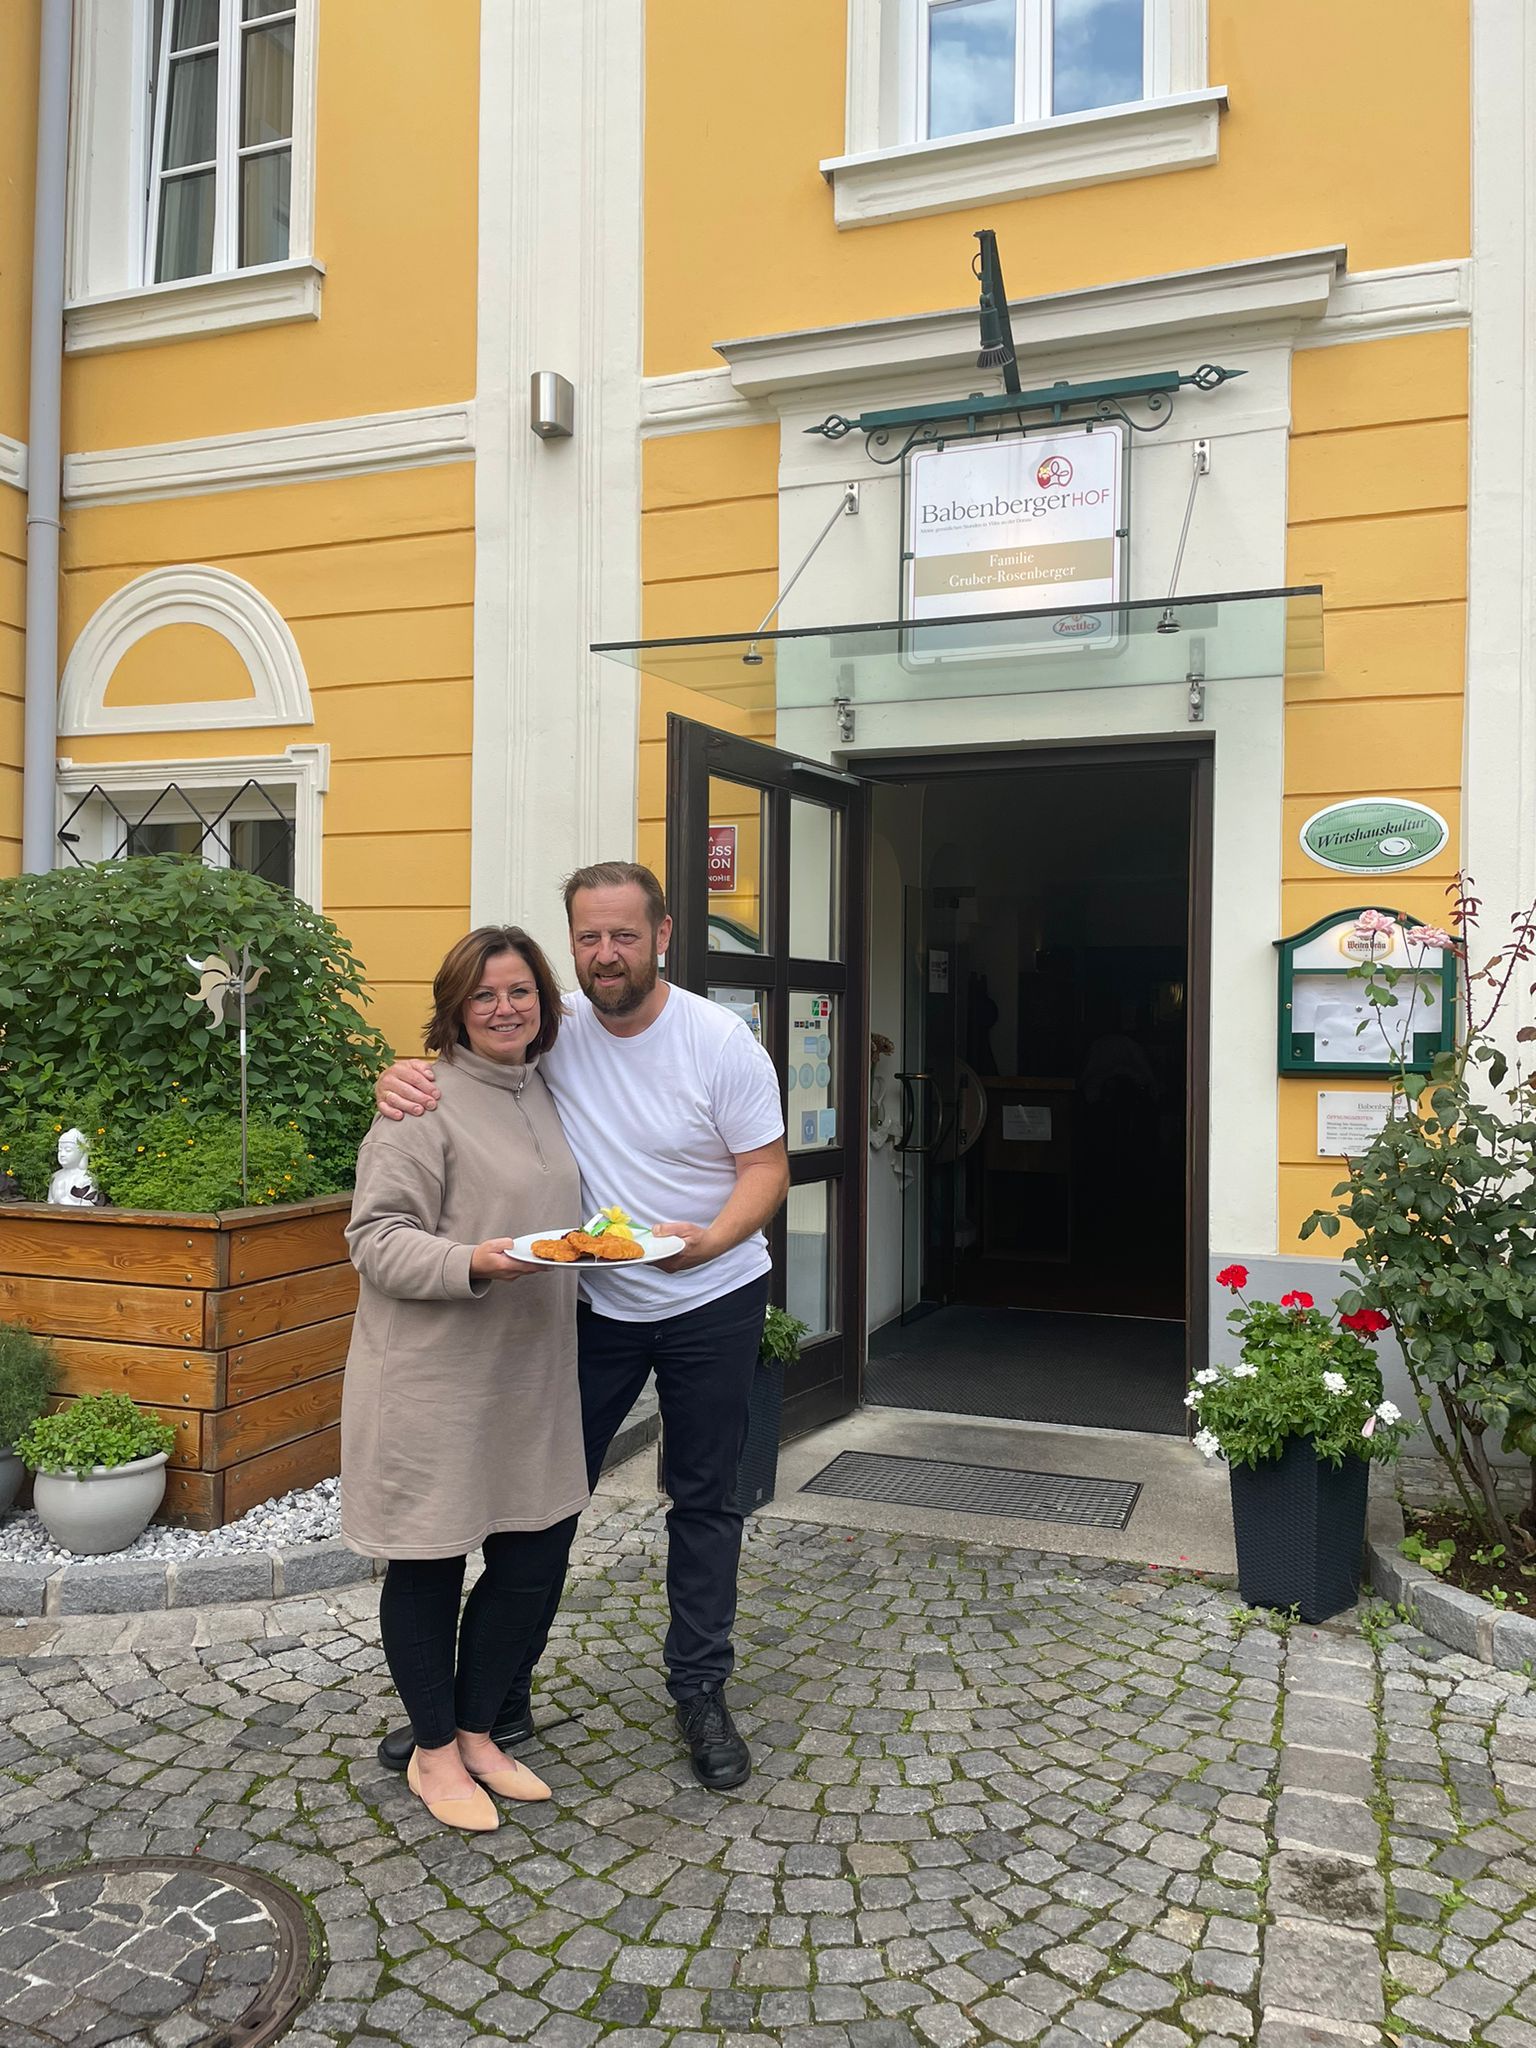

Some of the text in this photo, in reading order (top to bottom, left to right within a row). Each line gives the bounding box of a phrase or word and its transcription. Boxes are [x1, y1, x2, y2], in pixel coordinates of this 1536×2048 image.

[989, 552, 1035, 567] Familie
[949, 566, 1076, 587] Gruber-Rosenberger
[1057, 620, 1097, 633] Zwettler
[1317, 818, 1428, 849] Wirtshauskultur
